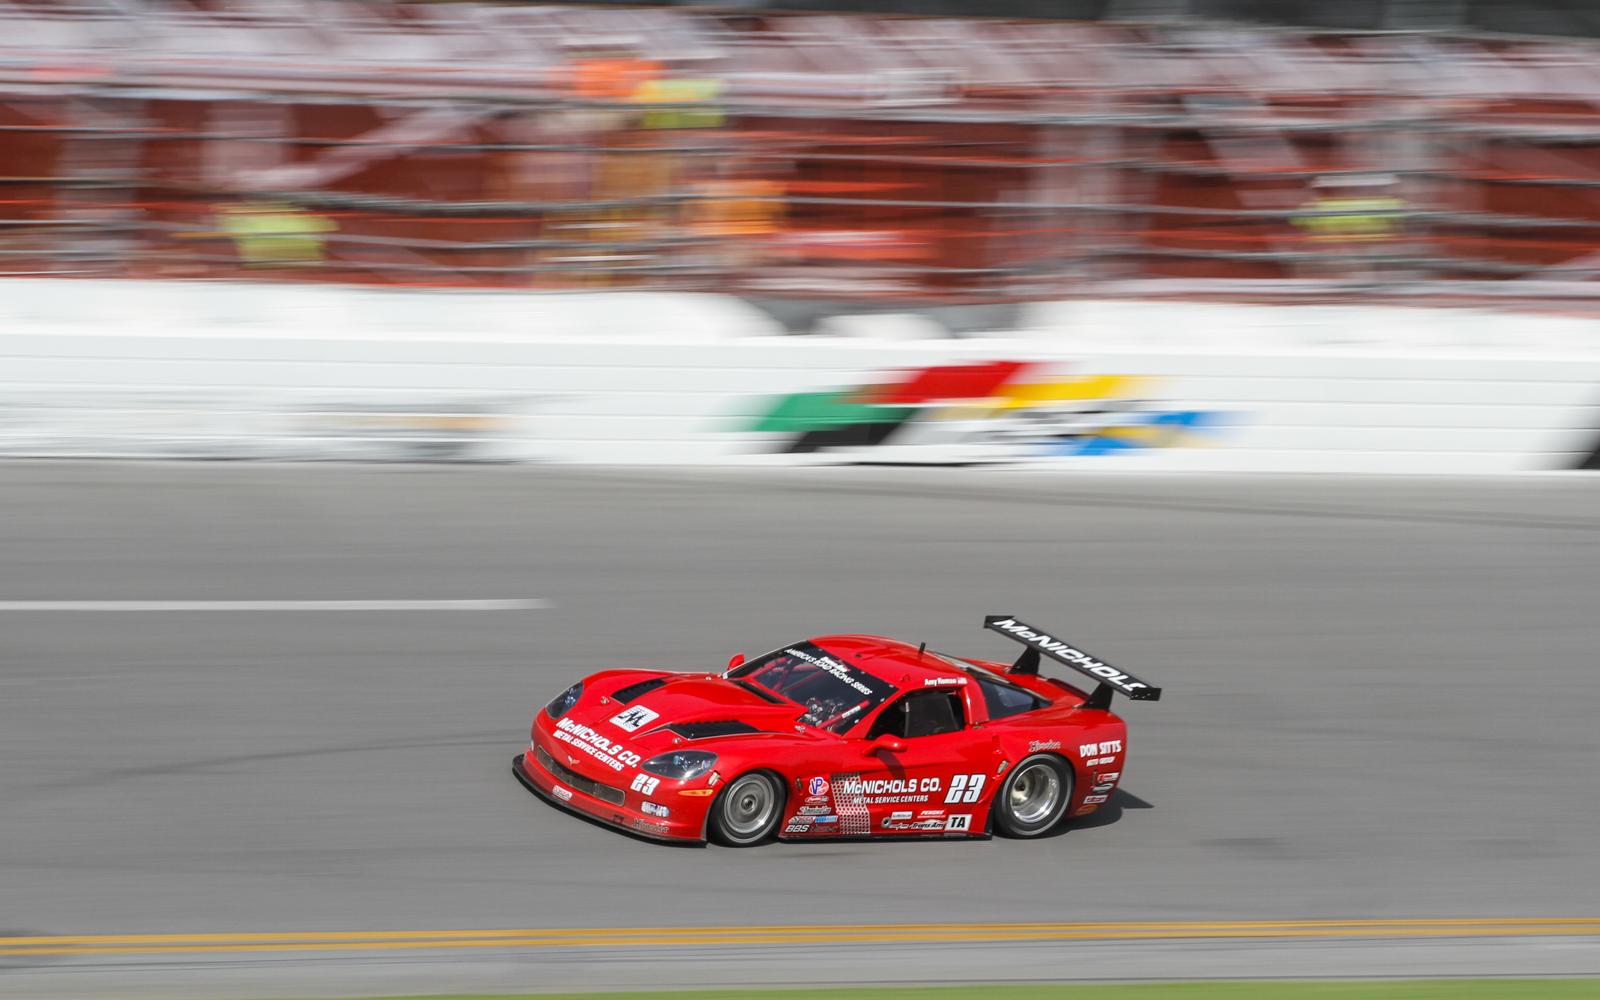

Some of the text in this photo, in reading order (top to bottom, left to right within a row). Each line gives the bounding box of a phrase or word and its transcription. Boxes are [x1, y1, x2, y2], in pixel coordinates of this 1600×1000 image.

[812, 659, 832, 671] ROAD
[828, 668, 854, 684] RACING
[851, 681, 873, 695] SERIES
[553, 729, 624, 771] METAL SERVICE CENTERS
[1080, 740, 1121, 757] DON SITTS
[617, 750, 641, 768] CO.
[630, 773, 660, 796] 23
[843, 777, 942, 794] McNICHOLS CO.
[944, 774, 986, 804] 23
[875, 796, 899, 804] SERVICE
[900, 795, 928, 803] CENTERS
[785, 824, 810, 832] BBS
[951, 817, 966, 828] TA
